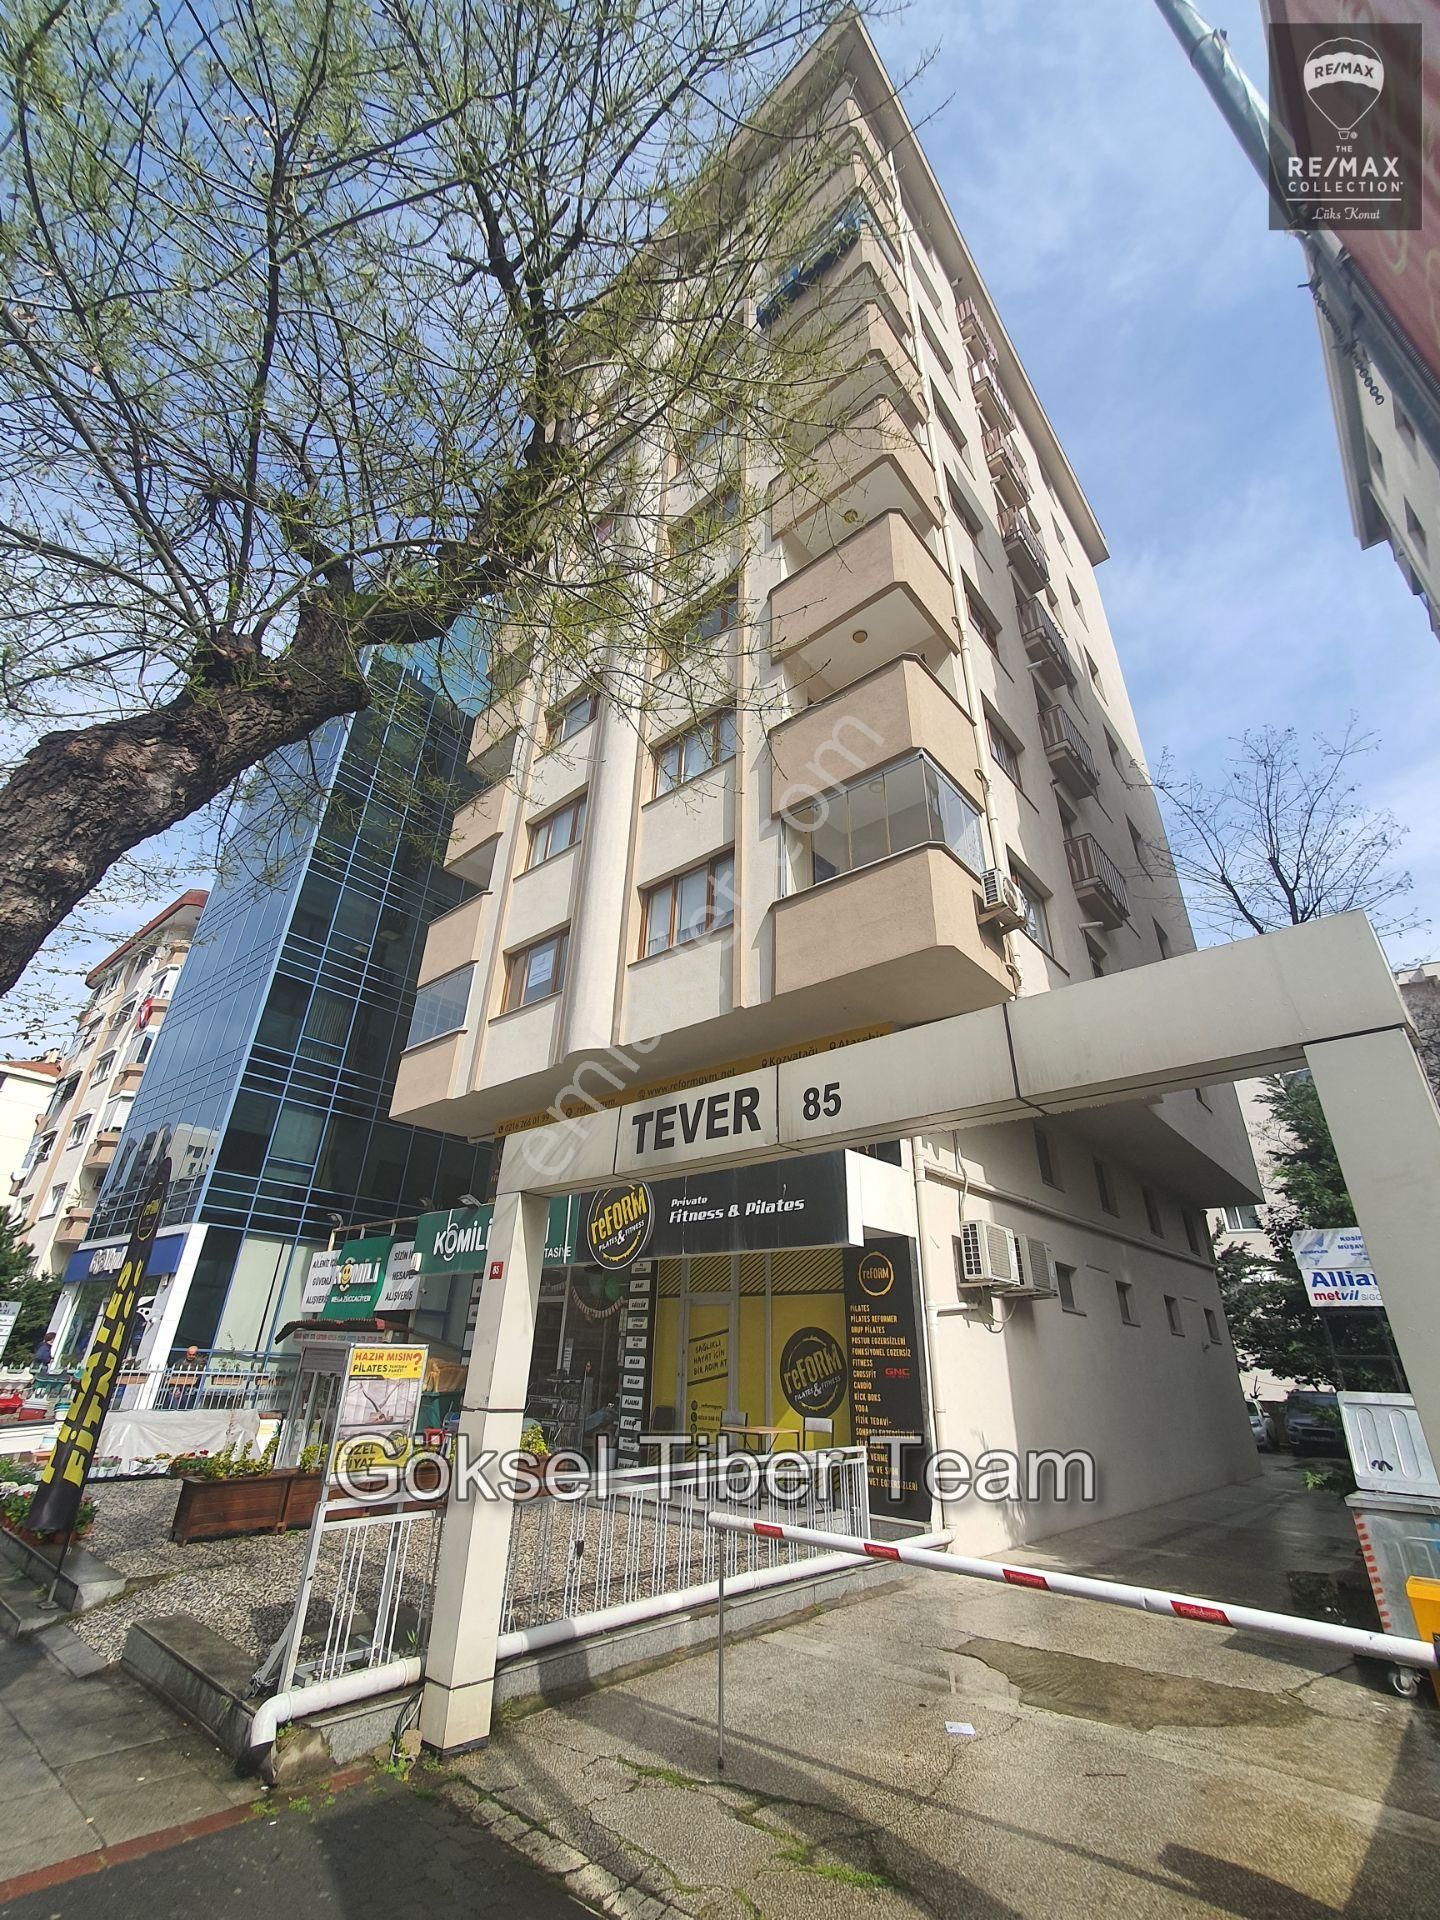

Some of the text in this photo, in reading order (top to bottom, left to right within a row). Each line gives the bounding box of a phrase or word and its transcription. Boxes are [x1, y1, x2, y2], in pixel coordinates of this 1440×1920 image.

[631, 1081, 842, 1155] TEVER 85
[671, 1196, 708, 1208] Private
[669, 1199, 805, 1224] Fitness & Pilates
[1313, 1289, 1359, 1301] metvil
[355, 1352, 385, 1361] HAZIR
[693, 1352, 712, 1365] HAYAT
[353, 1362, 388, 1373] PİLATES
[884, 1367, 911, 1376] GNC
